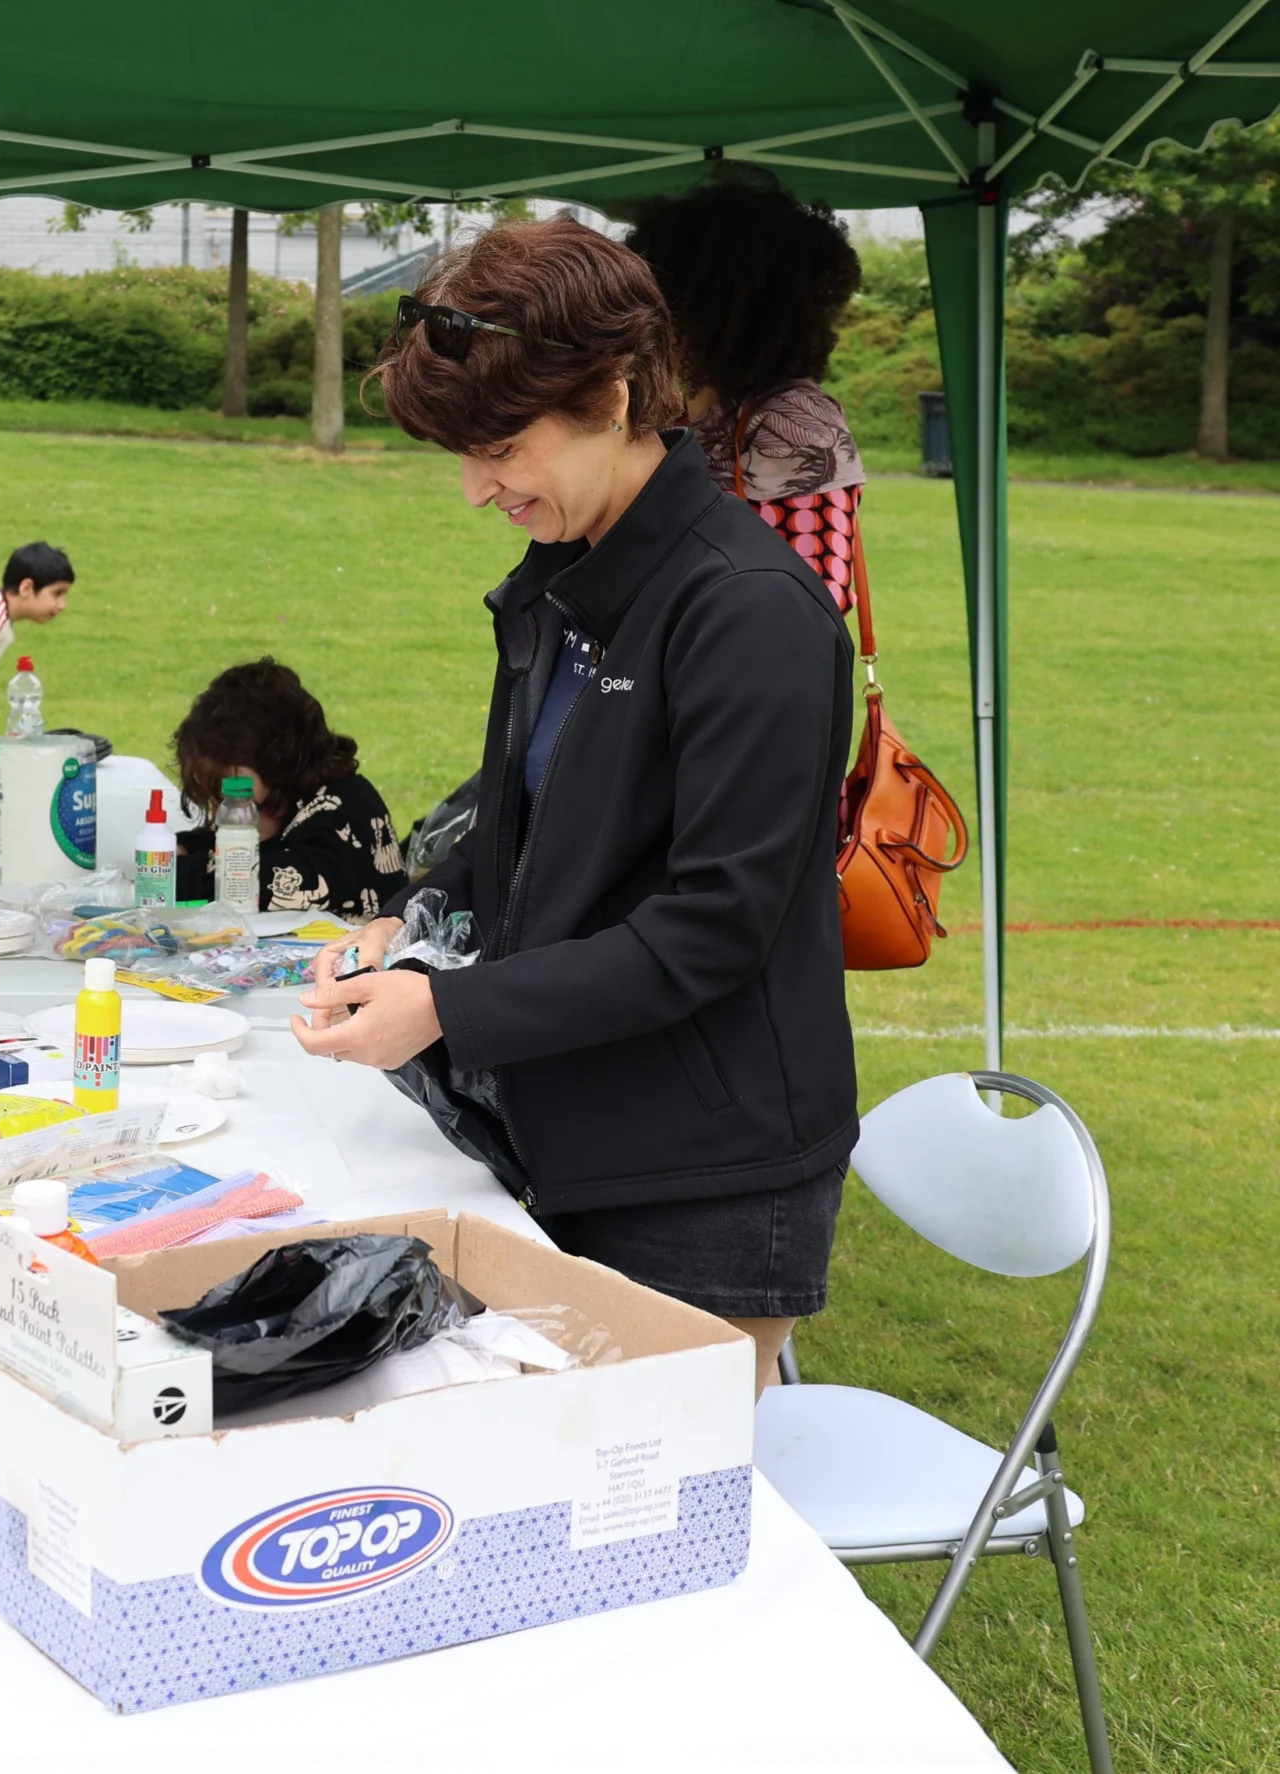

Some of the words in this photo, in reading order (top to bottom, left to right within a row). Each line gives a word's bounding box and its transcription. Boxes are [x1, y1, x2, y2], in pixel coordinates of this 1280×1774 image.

[85, 1062, 118, 1072] PAINT
[10, 1276, 26, 1304] 15
[28, 1286, 61, 1324] Pack
[19, 1308, 53, 1348] Paint
[55, 1330, 107, 1380] Palettes
[328, 1502, 375, 1522] FINEST
[277, 1518, 364, 1577] TOP
[359, 1508, 423, 1558] OP
[320, 1558, 378, 1580] QUALITY
